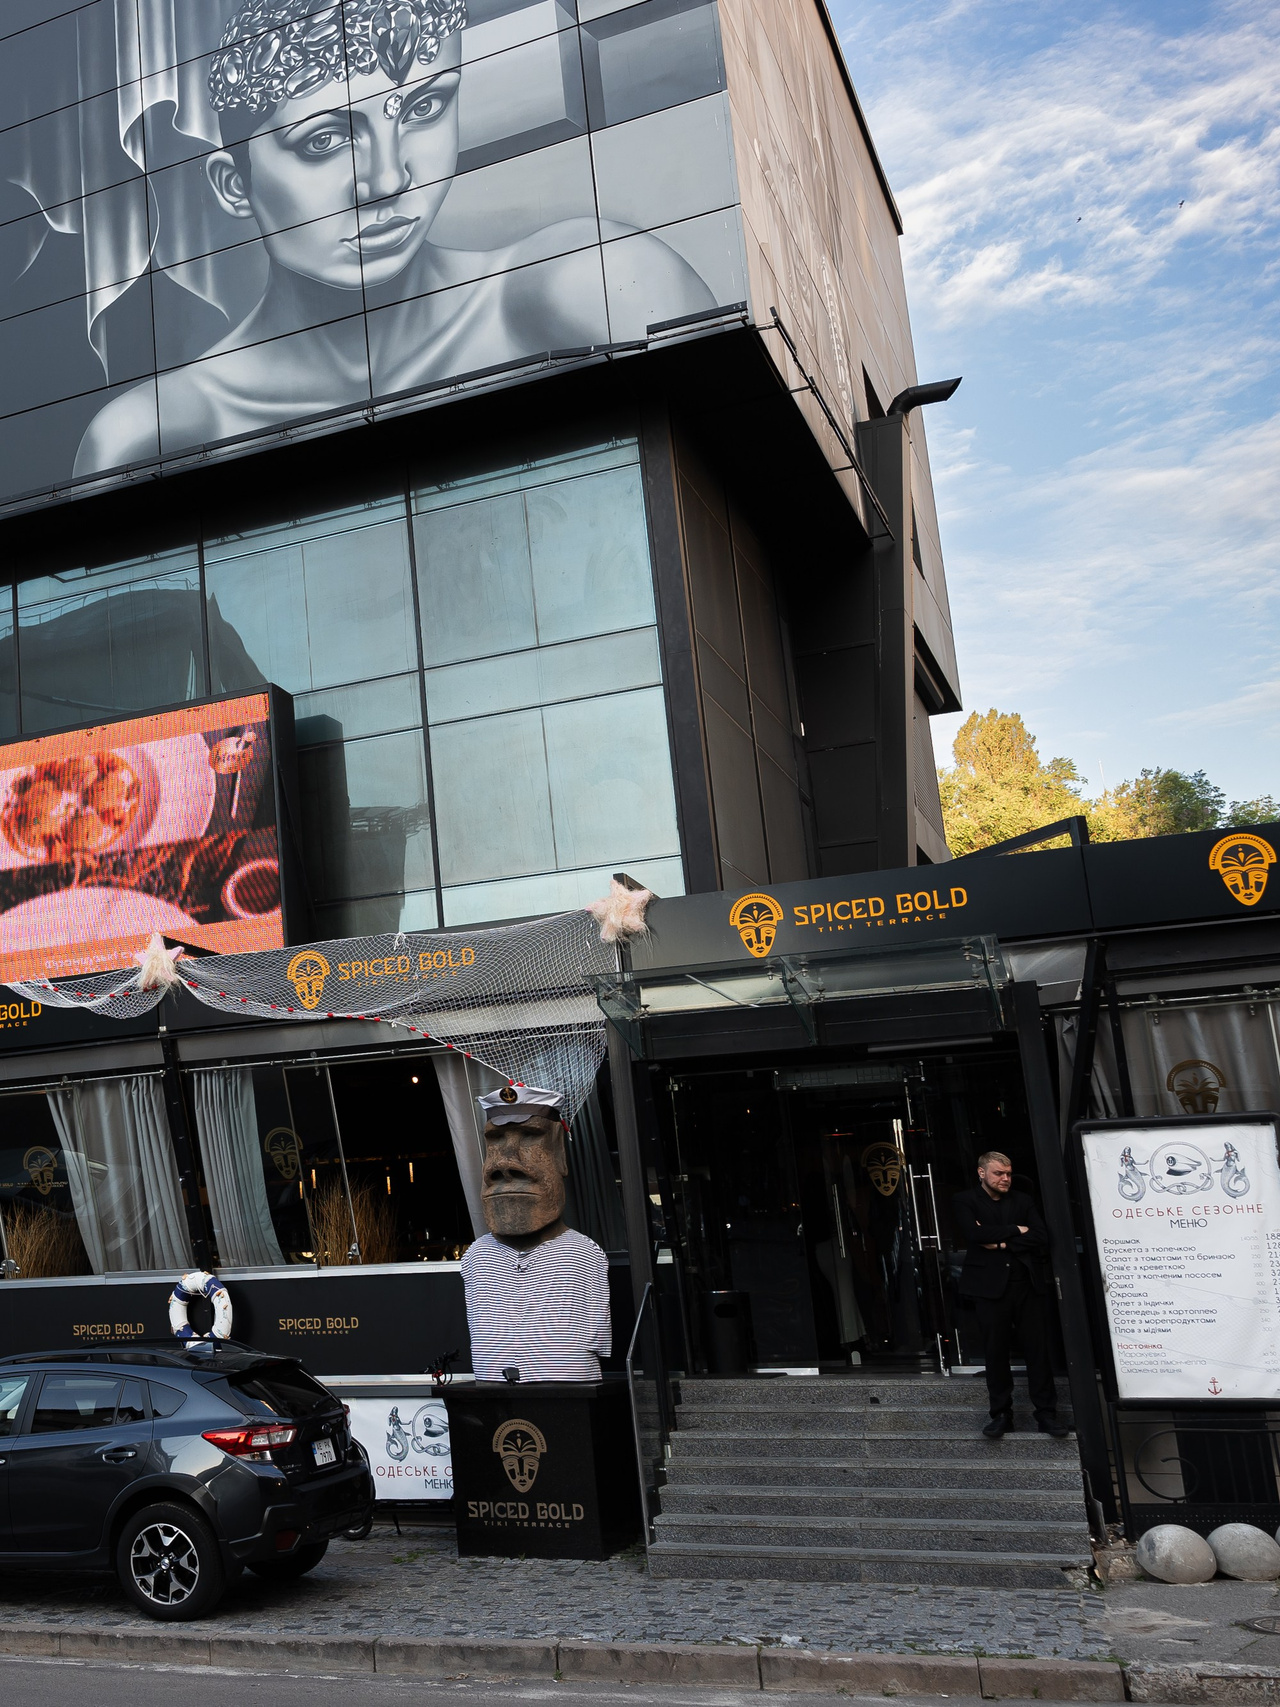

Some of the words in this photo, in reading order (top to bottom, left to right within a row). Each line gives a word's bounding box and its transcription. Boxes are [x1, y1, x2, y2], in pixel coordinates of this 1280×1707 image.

[793, 897, 885, 926] SPICED
[896, 887, 968, 914] GOLD
[818, 924, 853, 933] TIKI
[866, 912, 946, 927] TERRACE
[338, 955, 410, 980] SPICED
[419, 947, 475, 971] GOLD
[1112, 1206, 1183, 1219] ОДЕСЬКЕ
[1192, 1204, 1263, 1215] СЕЗОННЕ
[1170, 1218, 1208, 1228] МЕНЮ
[73, 1324, 111, 1336] SPICED
[115, 1323, 144, 1335] GOLD
[279, 1318, 321, 1330] SPICED
[326, 1317, 359, 1329] GOLD
[1117, 1342, 1163, 1350] Настоянка
[376, 1466, 438, 1478] ОДЕСЬКЕ
[467, 1501, 529, 1519] SPICED
[536, 1502, 584, 1520] GOLD
